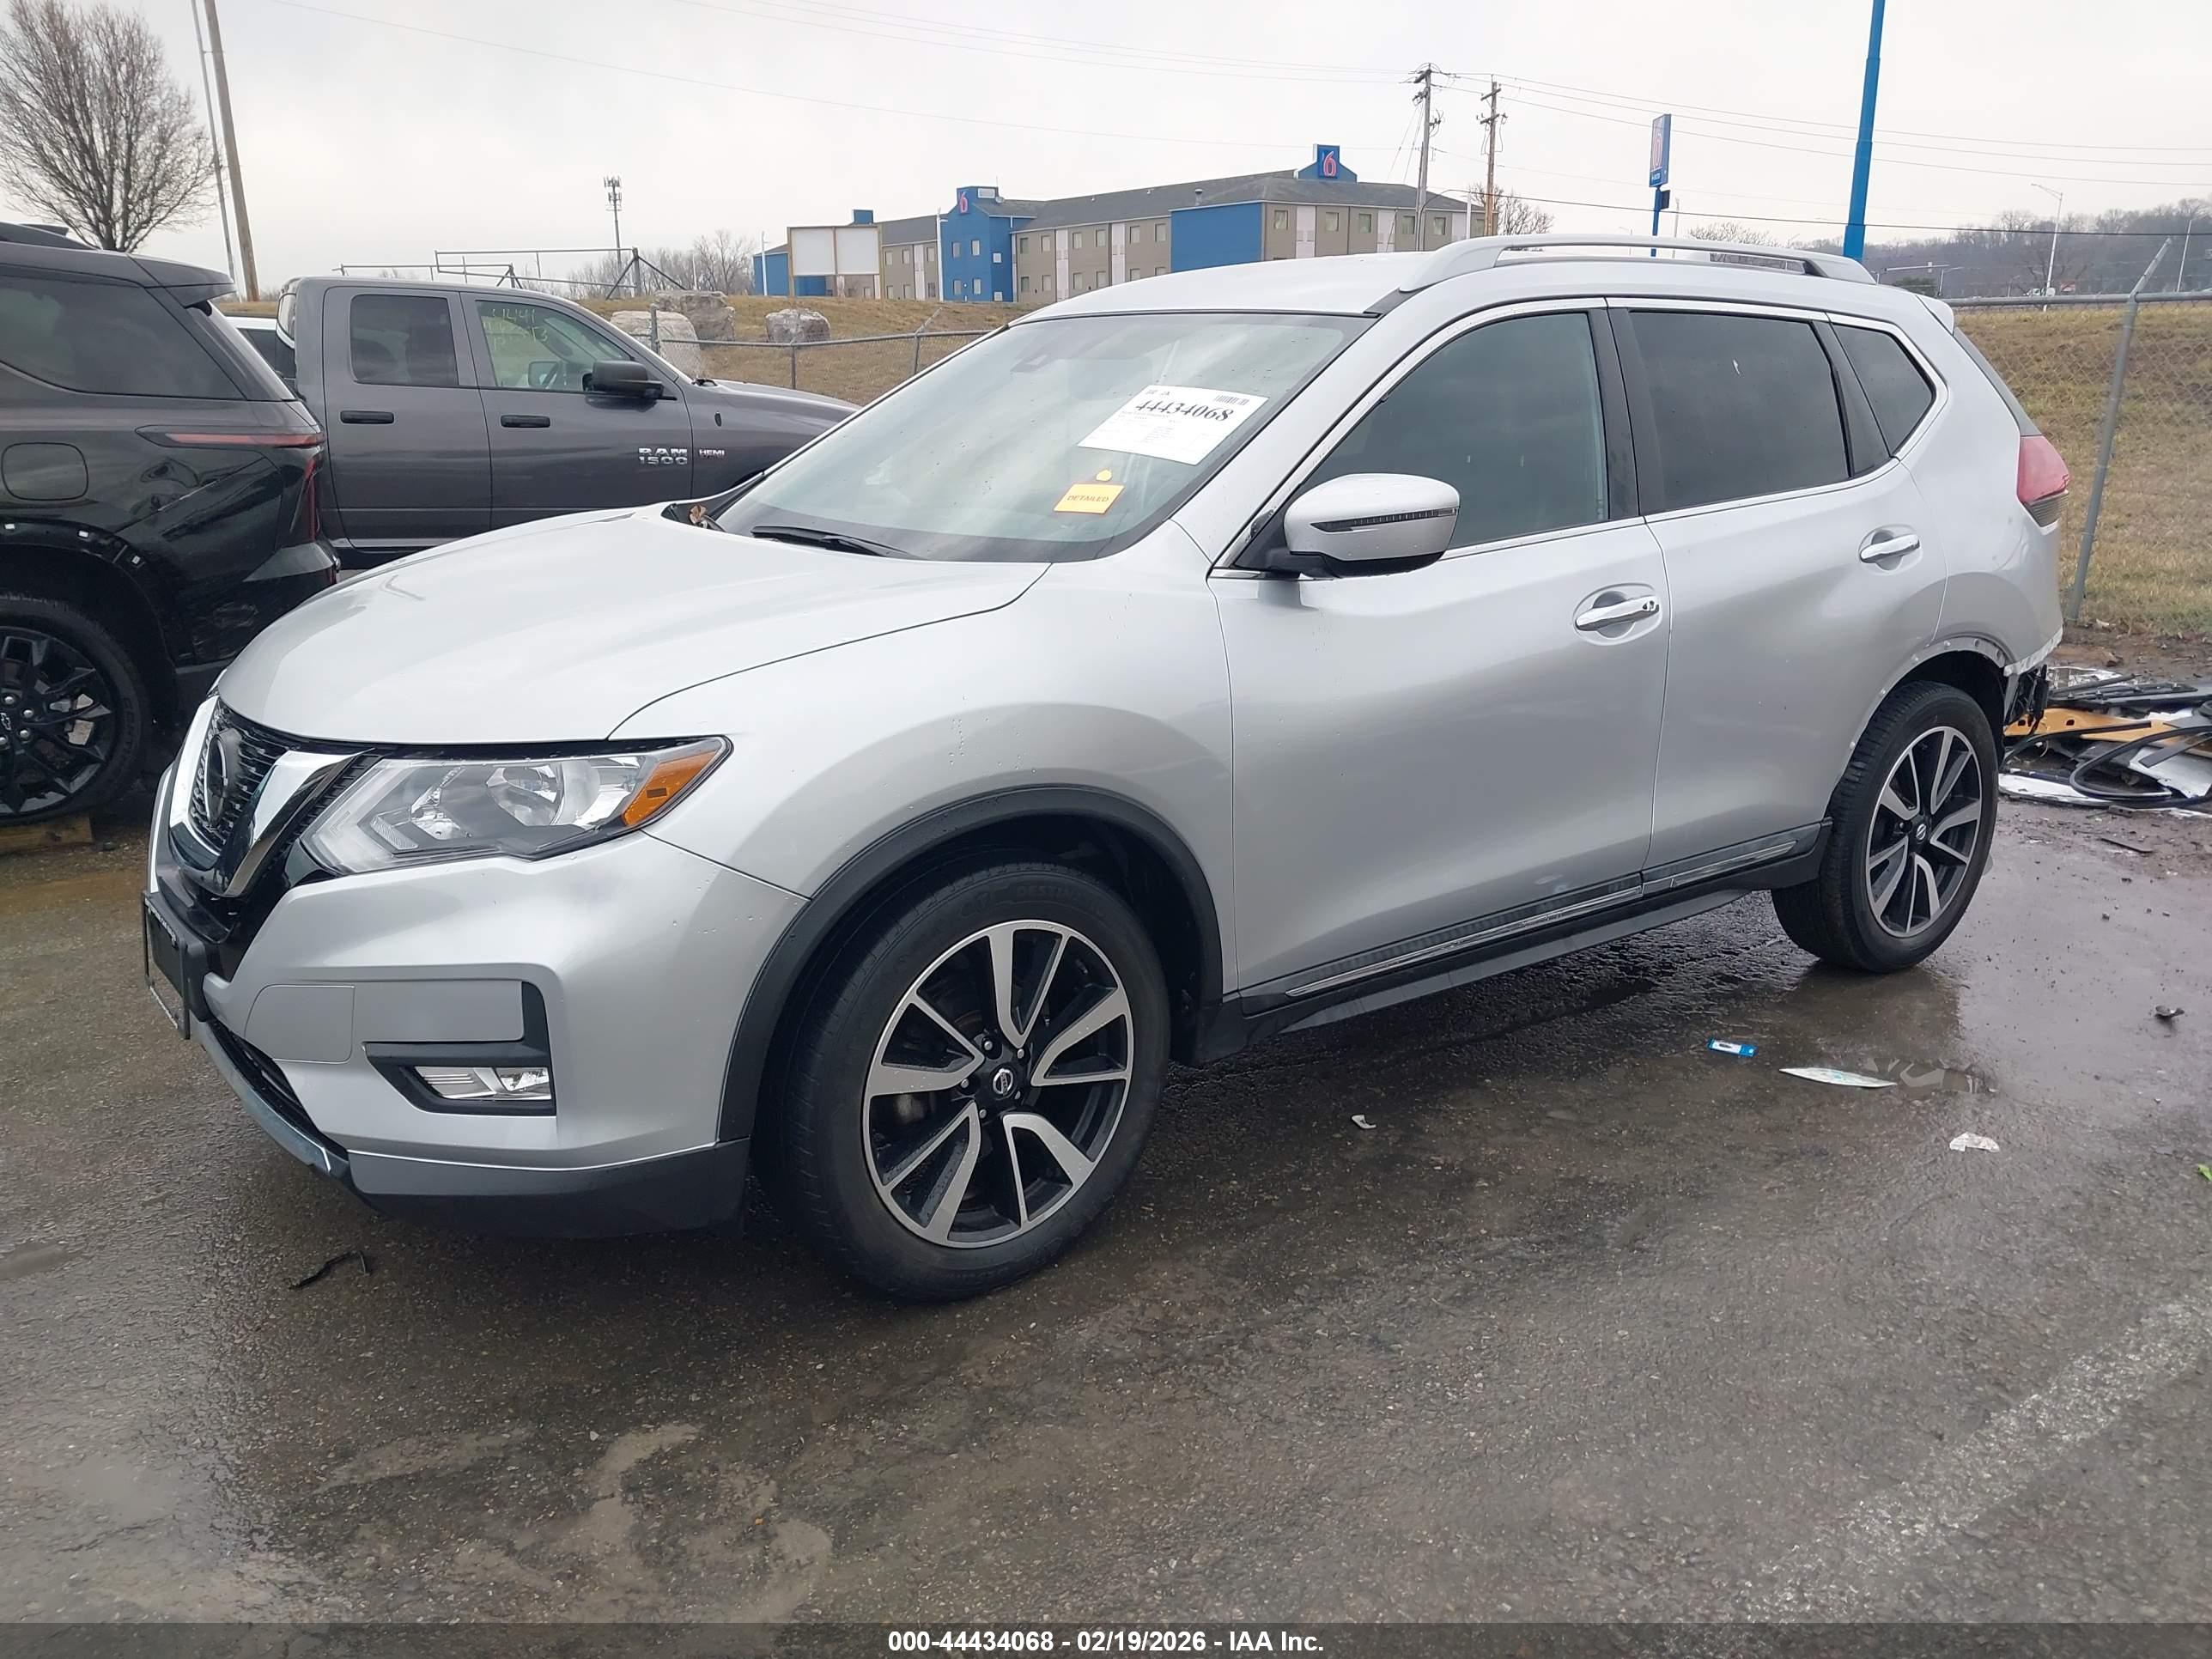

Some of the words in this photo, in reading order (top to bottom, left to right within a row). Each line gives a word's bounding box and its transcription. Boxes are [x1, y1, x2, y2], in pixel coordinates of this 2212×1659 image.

[1323, 150, 1337, 178] 6
[959, 191, 968, 214] 6
[1135, 399, 1235, 422] 44434068
[638, 447, 688, 456] RAM
[638, 456, 688, 465] 1500
